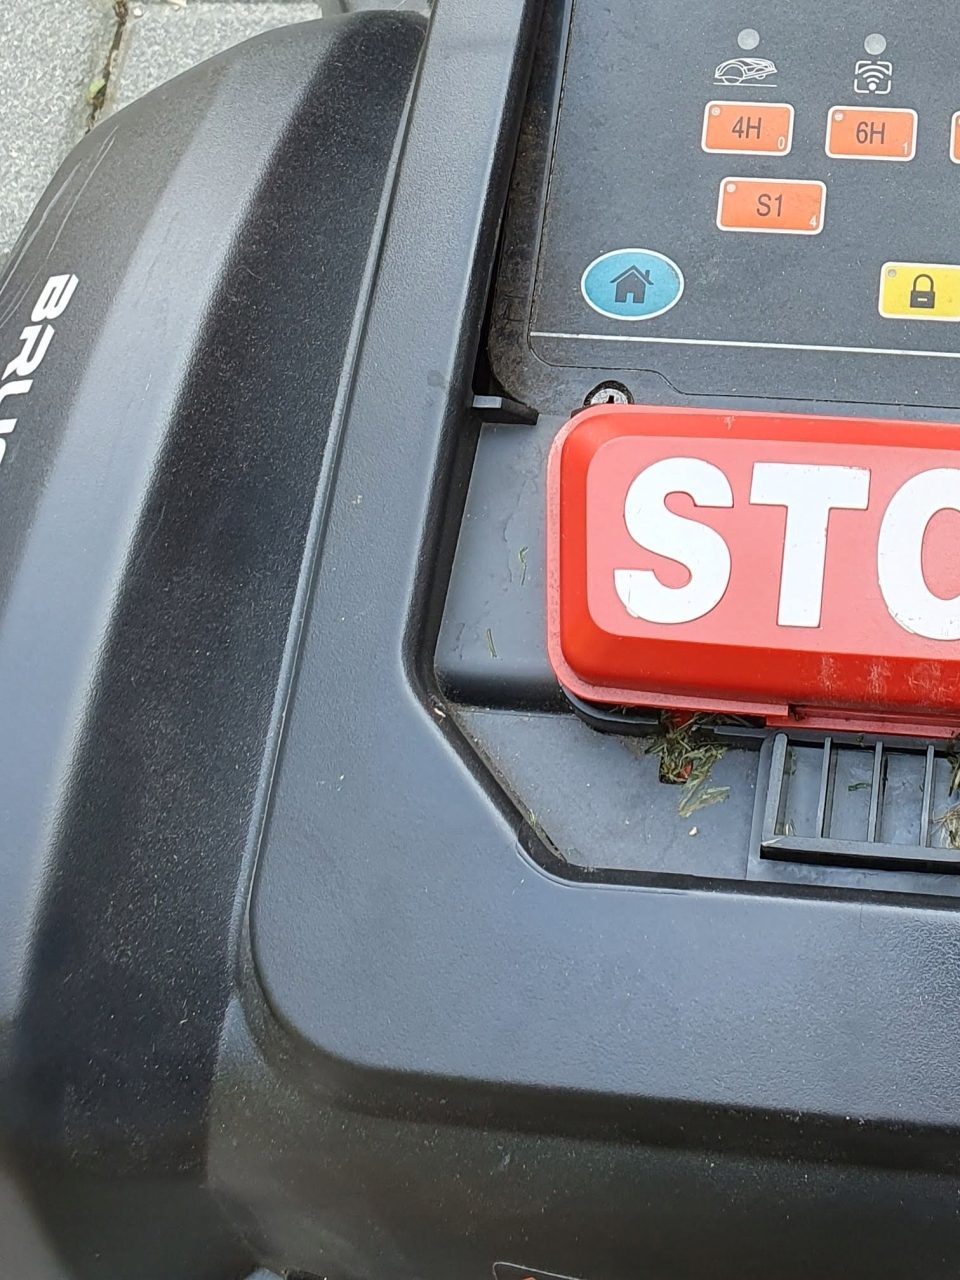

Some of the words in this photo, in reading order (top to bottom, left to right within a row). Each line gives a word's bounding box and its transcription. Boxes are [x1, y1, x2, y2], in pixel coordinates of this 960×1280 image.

[731, 116, 762, 140] 4H
[855, 121, 886, 145] 6H
[777, 136, 786, 150] 0
[901, 141, 909, 155] 1
[756, 193, 783, 218] S1
[808, 214, 817, 228] 4
